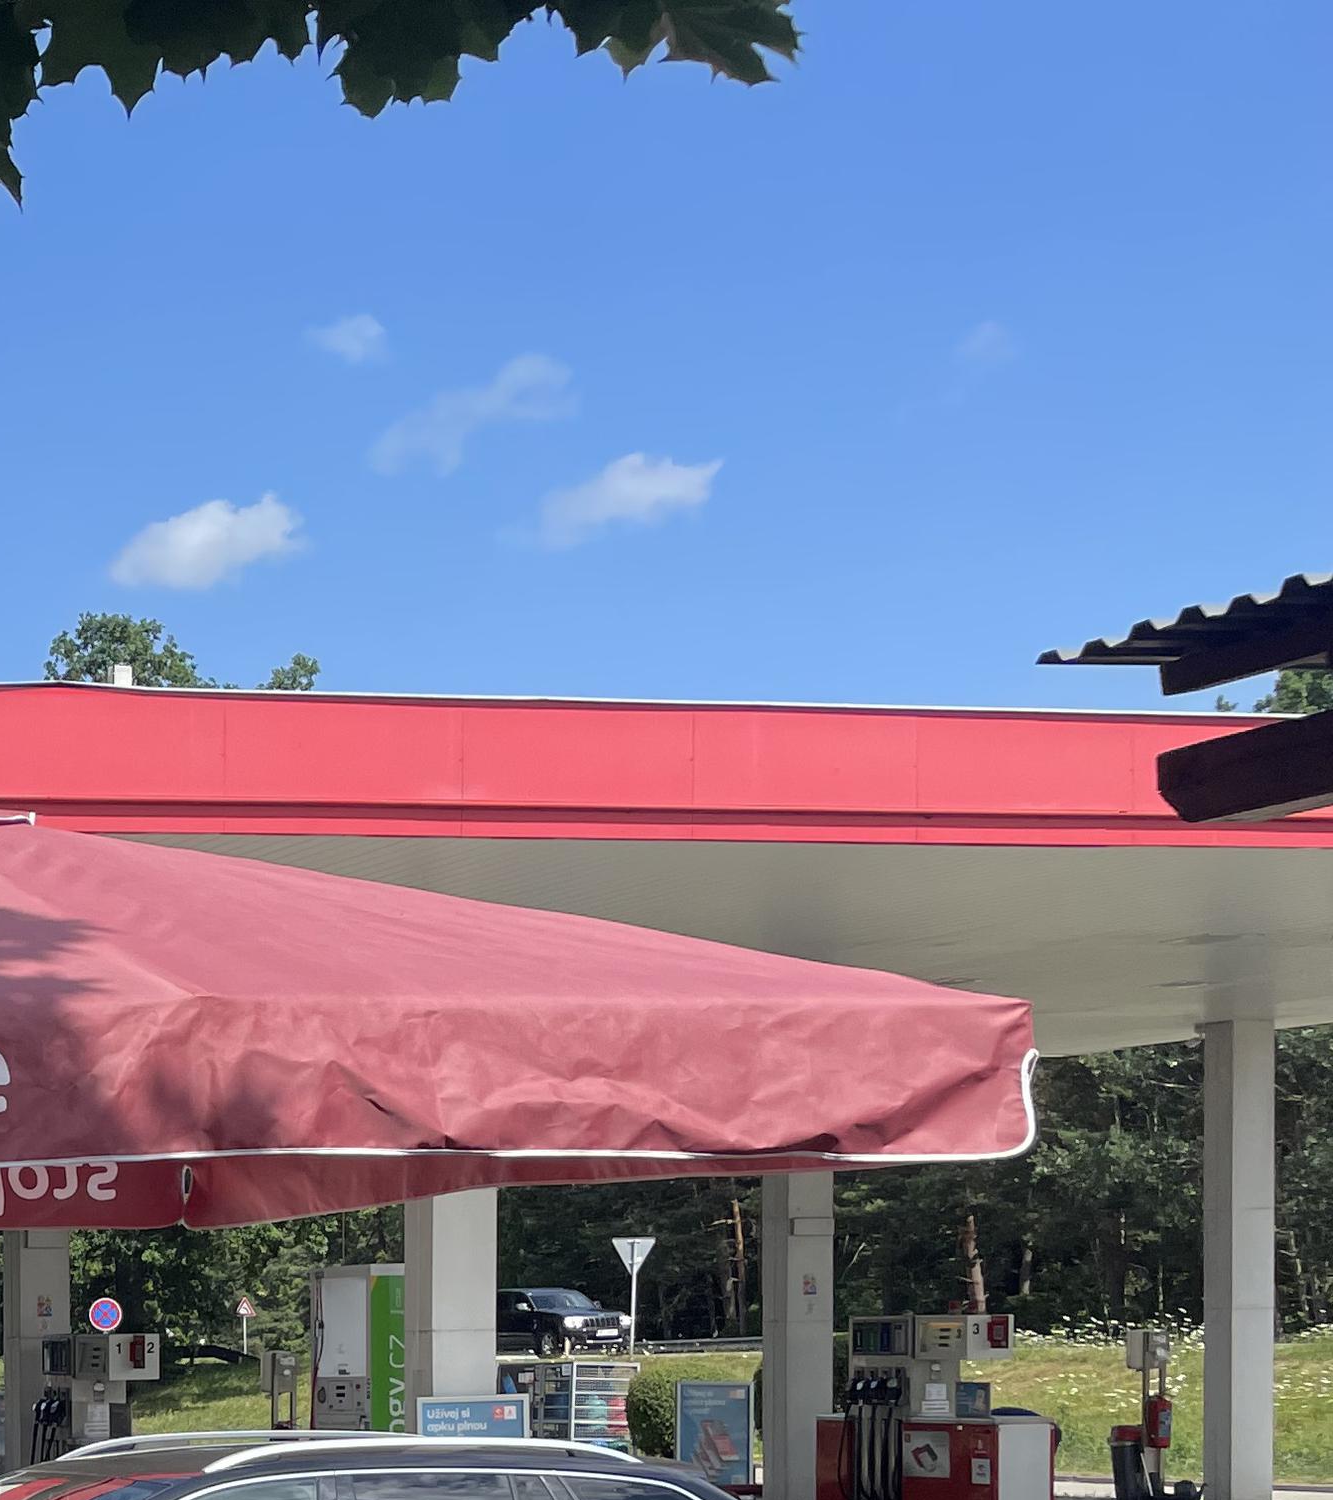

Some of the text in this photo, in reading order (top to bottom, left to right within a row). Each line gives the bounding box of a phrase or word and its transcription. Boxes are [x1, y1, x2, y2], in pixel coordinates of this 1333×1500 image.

[972, 1323, 980, 1335] 3
[116, 1341, 155, 1355] 1 2
